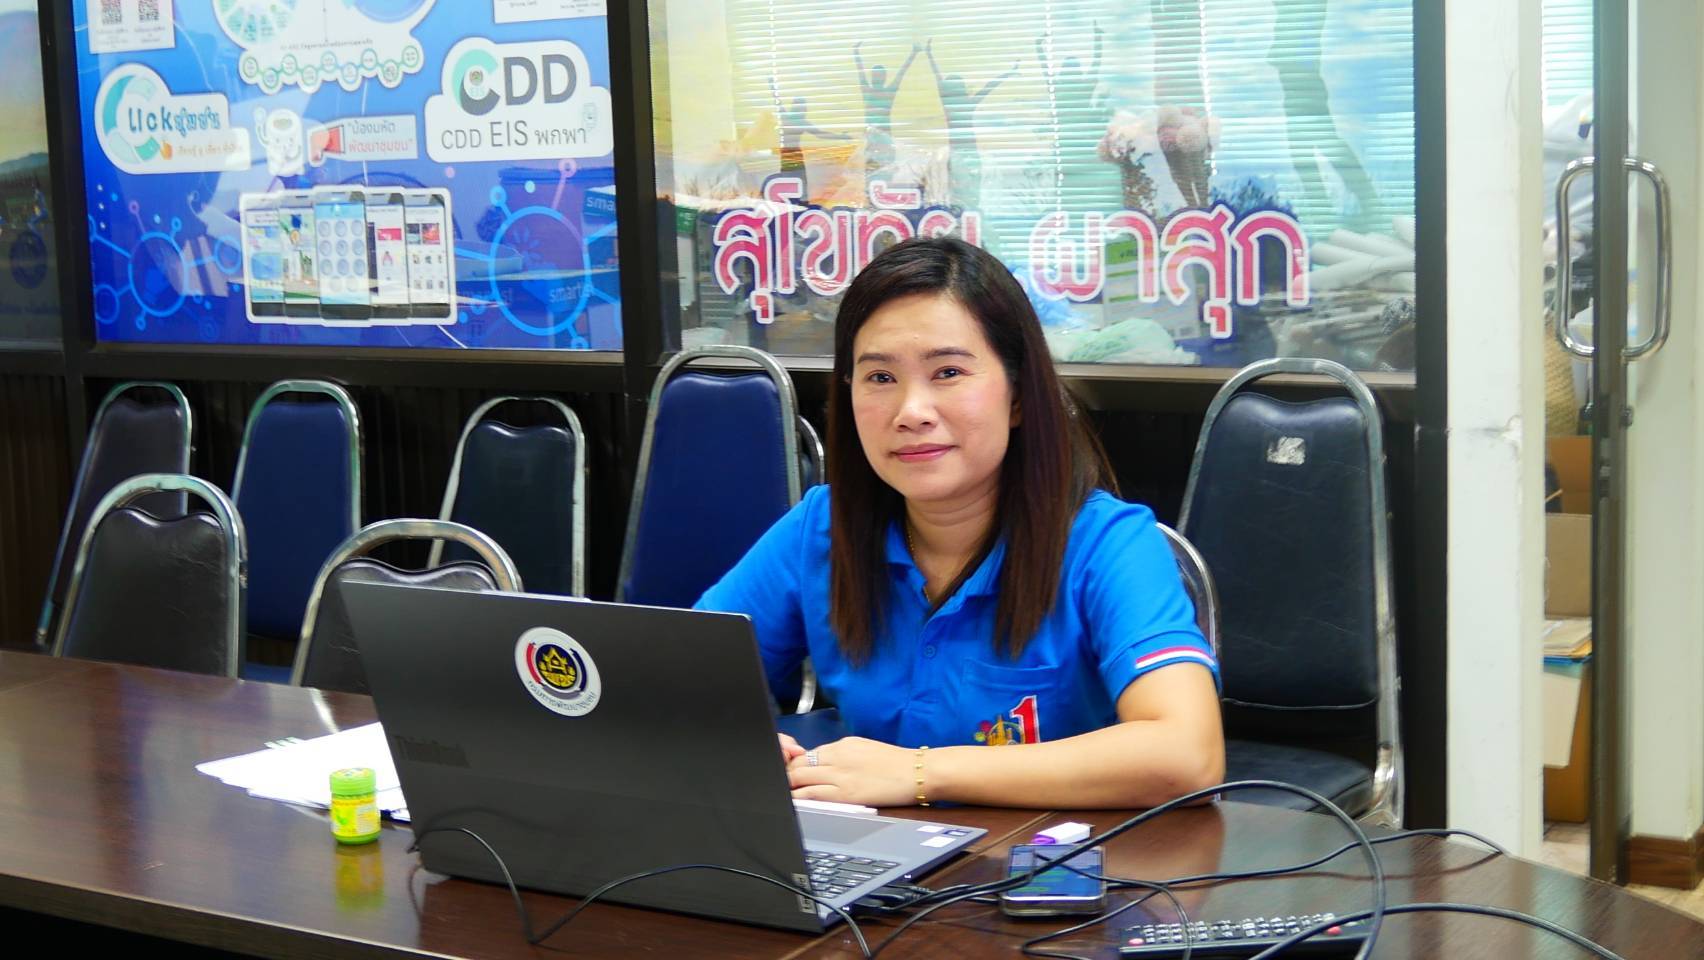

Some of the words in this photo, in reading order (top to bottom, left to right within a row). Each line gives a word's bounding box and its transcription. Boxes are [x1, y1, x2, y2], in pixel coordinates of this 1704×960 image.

[451, 49, 577, 116] CDD
[441, 128, 482, 150] CDD
[490, 120, 528, 147] EIS
[534, 128, 588, 146] พกพา
[1030, 205, 1311, 340] ผาสุก
